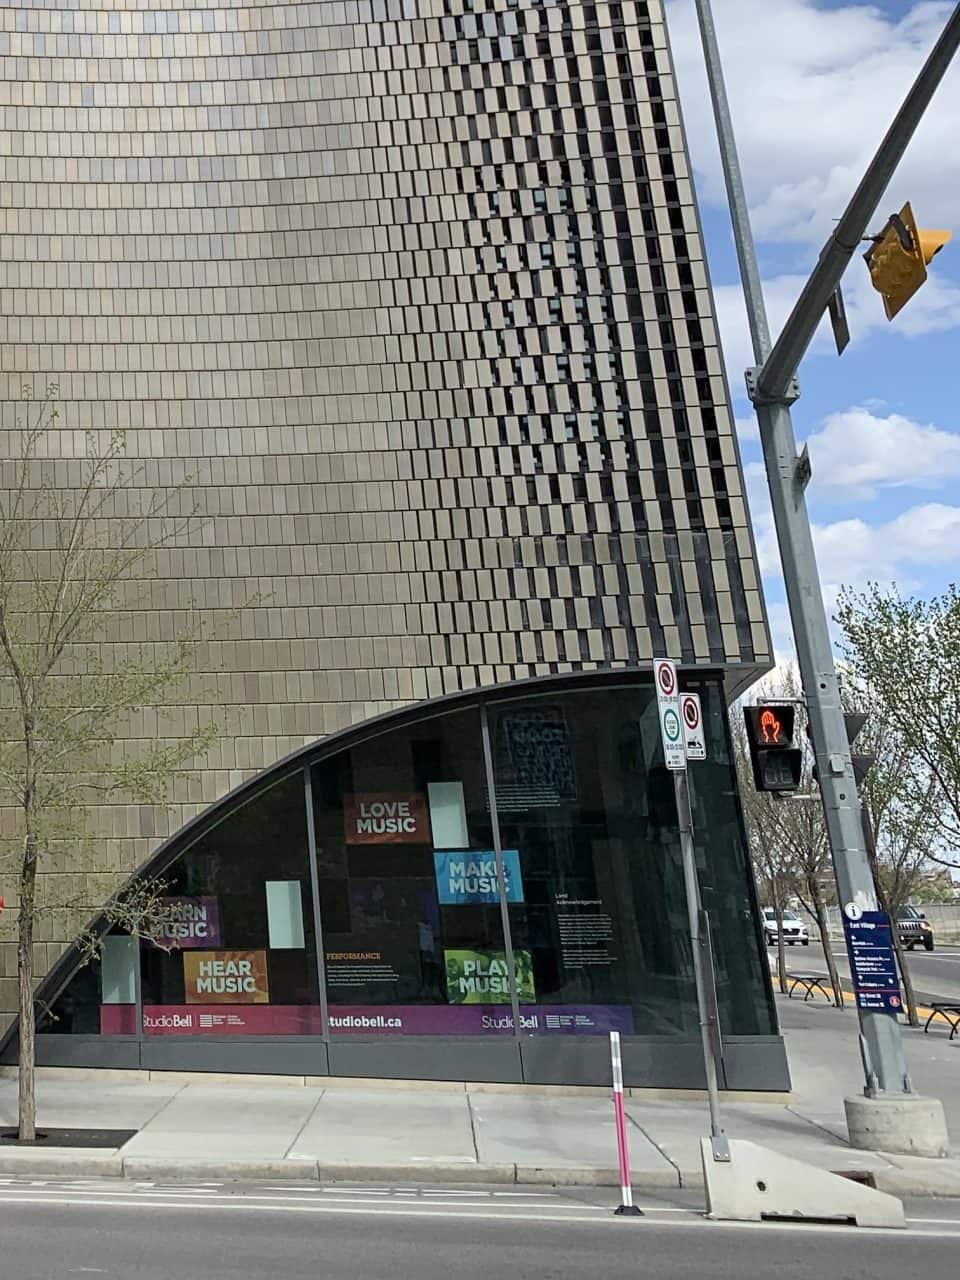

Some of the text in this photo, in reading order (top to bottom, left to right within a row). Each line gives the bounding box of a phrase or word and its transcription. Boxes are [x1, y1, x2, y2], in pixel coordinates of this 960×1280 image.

[359, 802, 410, 817] LOVE
[356, 817, 416, 834] MUSIC
[152, 904, 207, 920] EARN
[199, 960, 252, 977] HEAR
[463, 959, 510, 976] PLAY
[196, 977, 256, 993] MUSIC
[328, 1016, 402, 1028] tudiobell.ca
